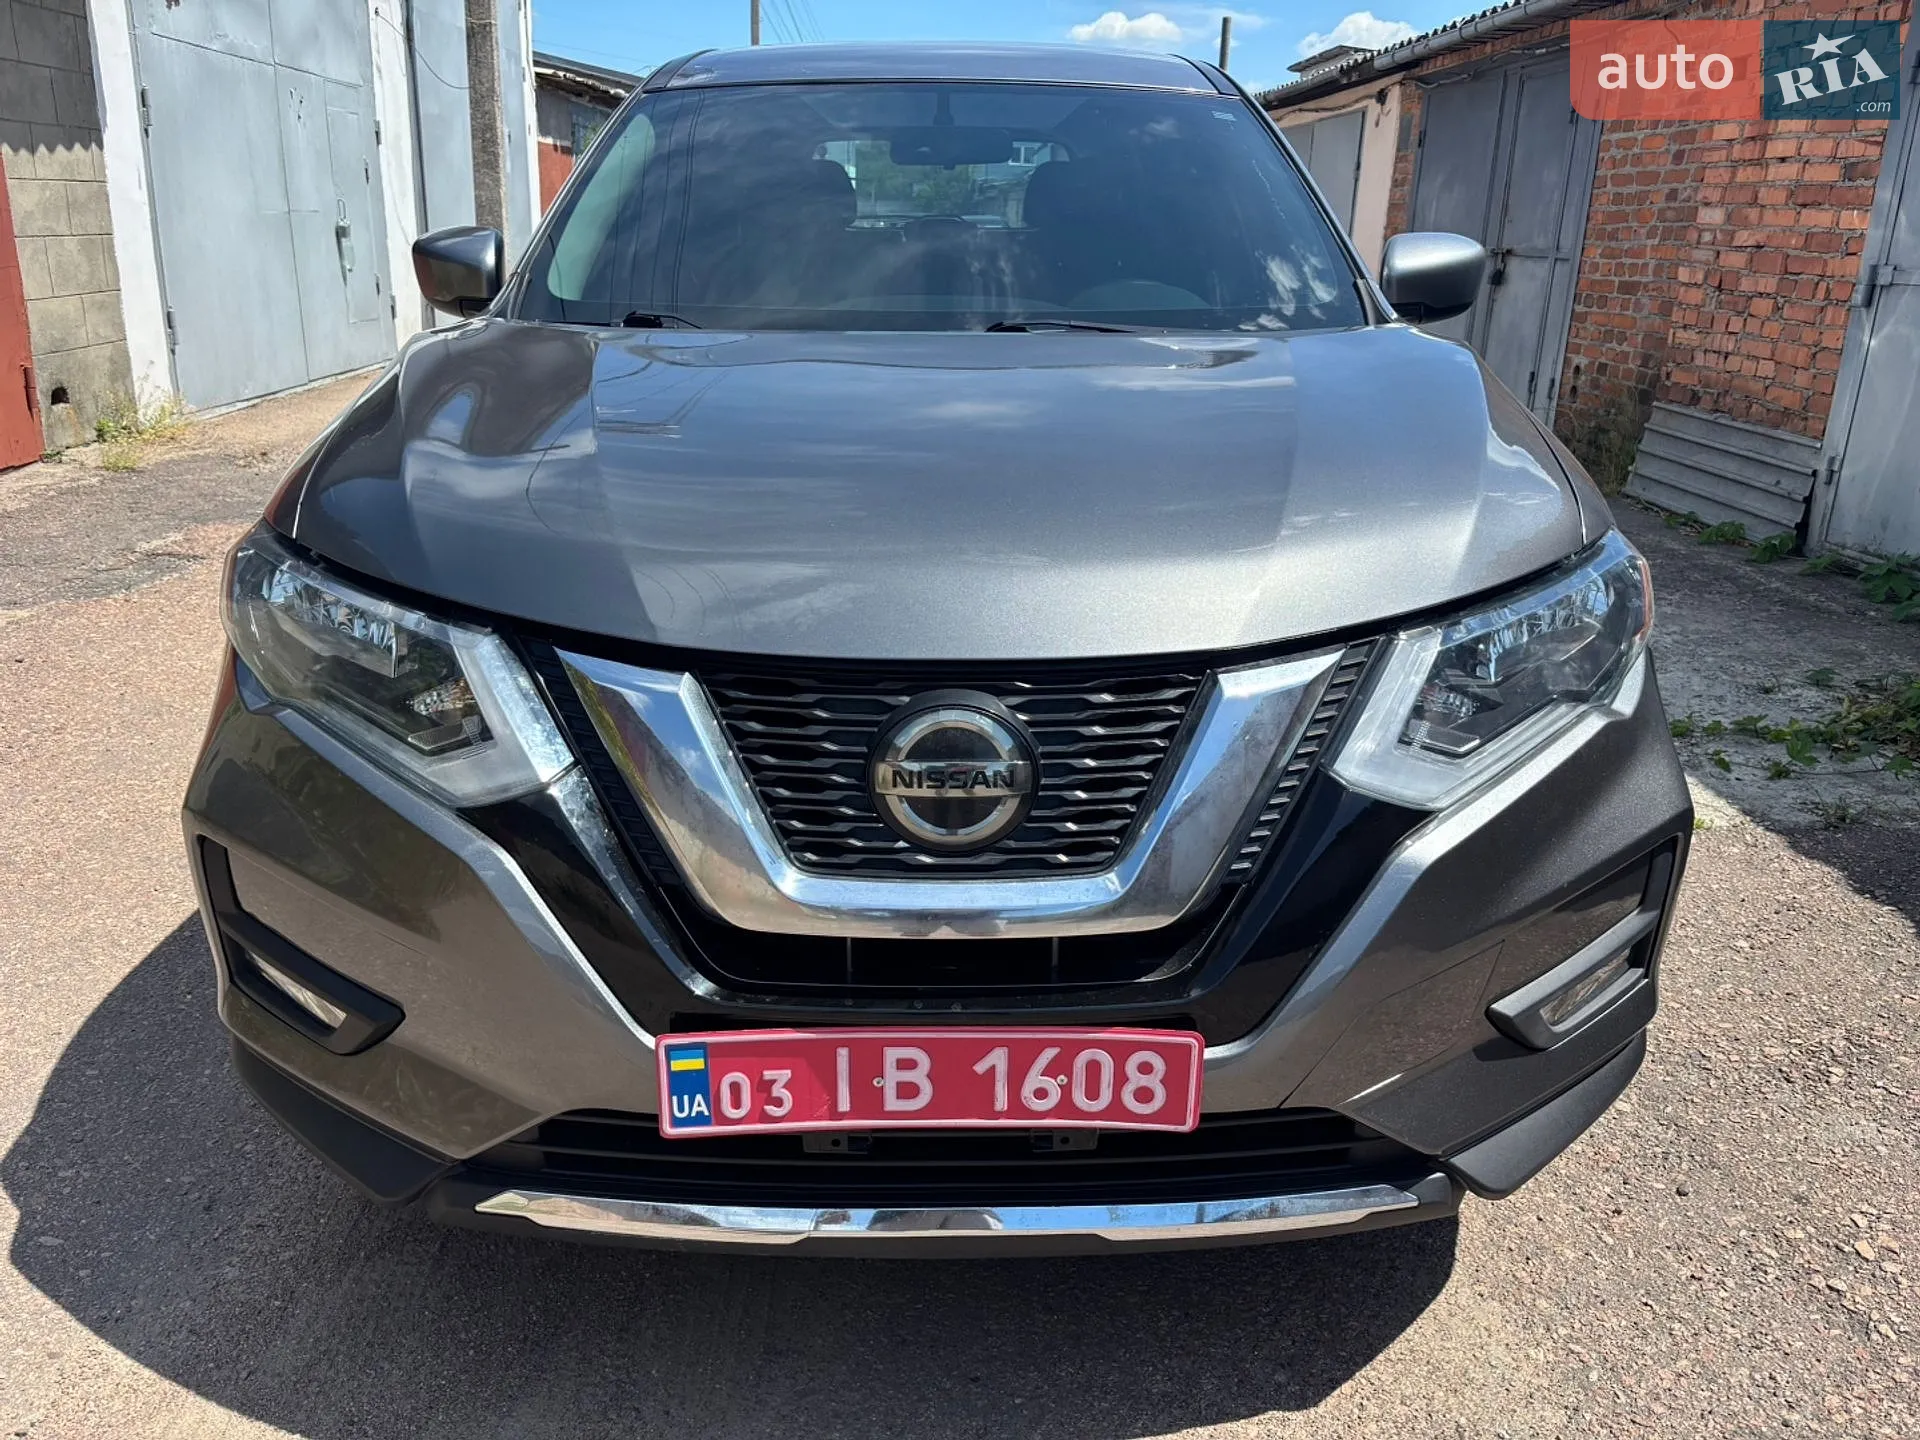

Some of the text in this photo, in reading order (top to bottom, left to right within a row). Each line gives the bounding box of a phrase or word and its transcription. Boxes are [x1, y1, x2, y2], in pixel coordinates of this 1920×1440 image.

[891, 769, 1016, 790] NISSAN
[719, 1069, 793, 1120] 03
[971, 1046, 1168, 1115] 1608
[672, 1095, 710, 1120] UA
